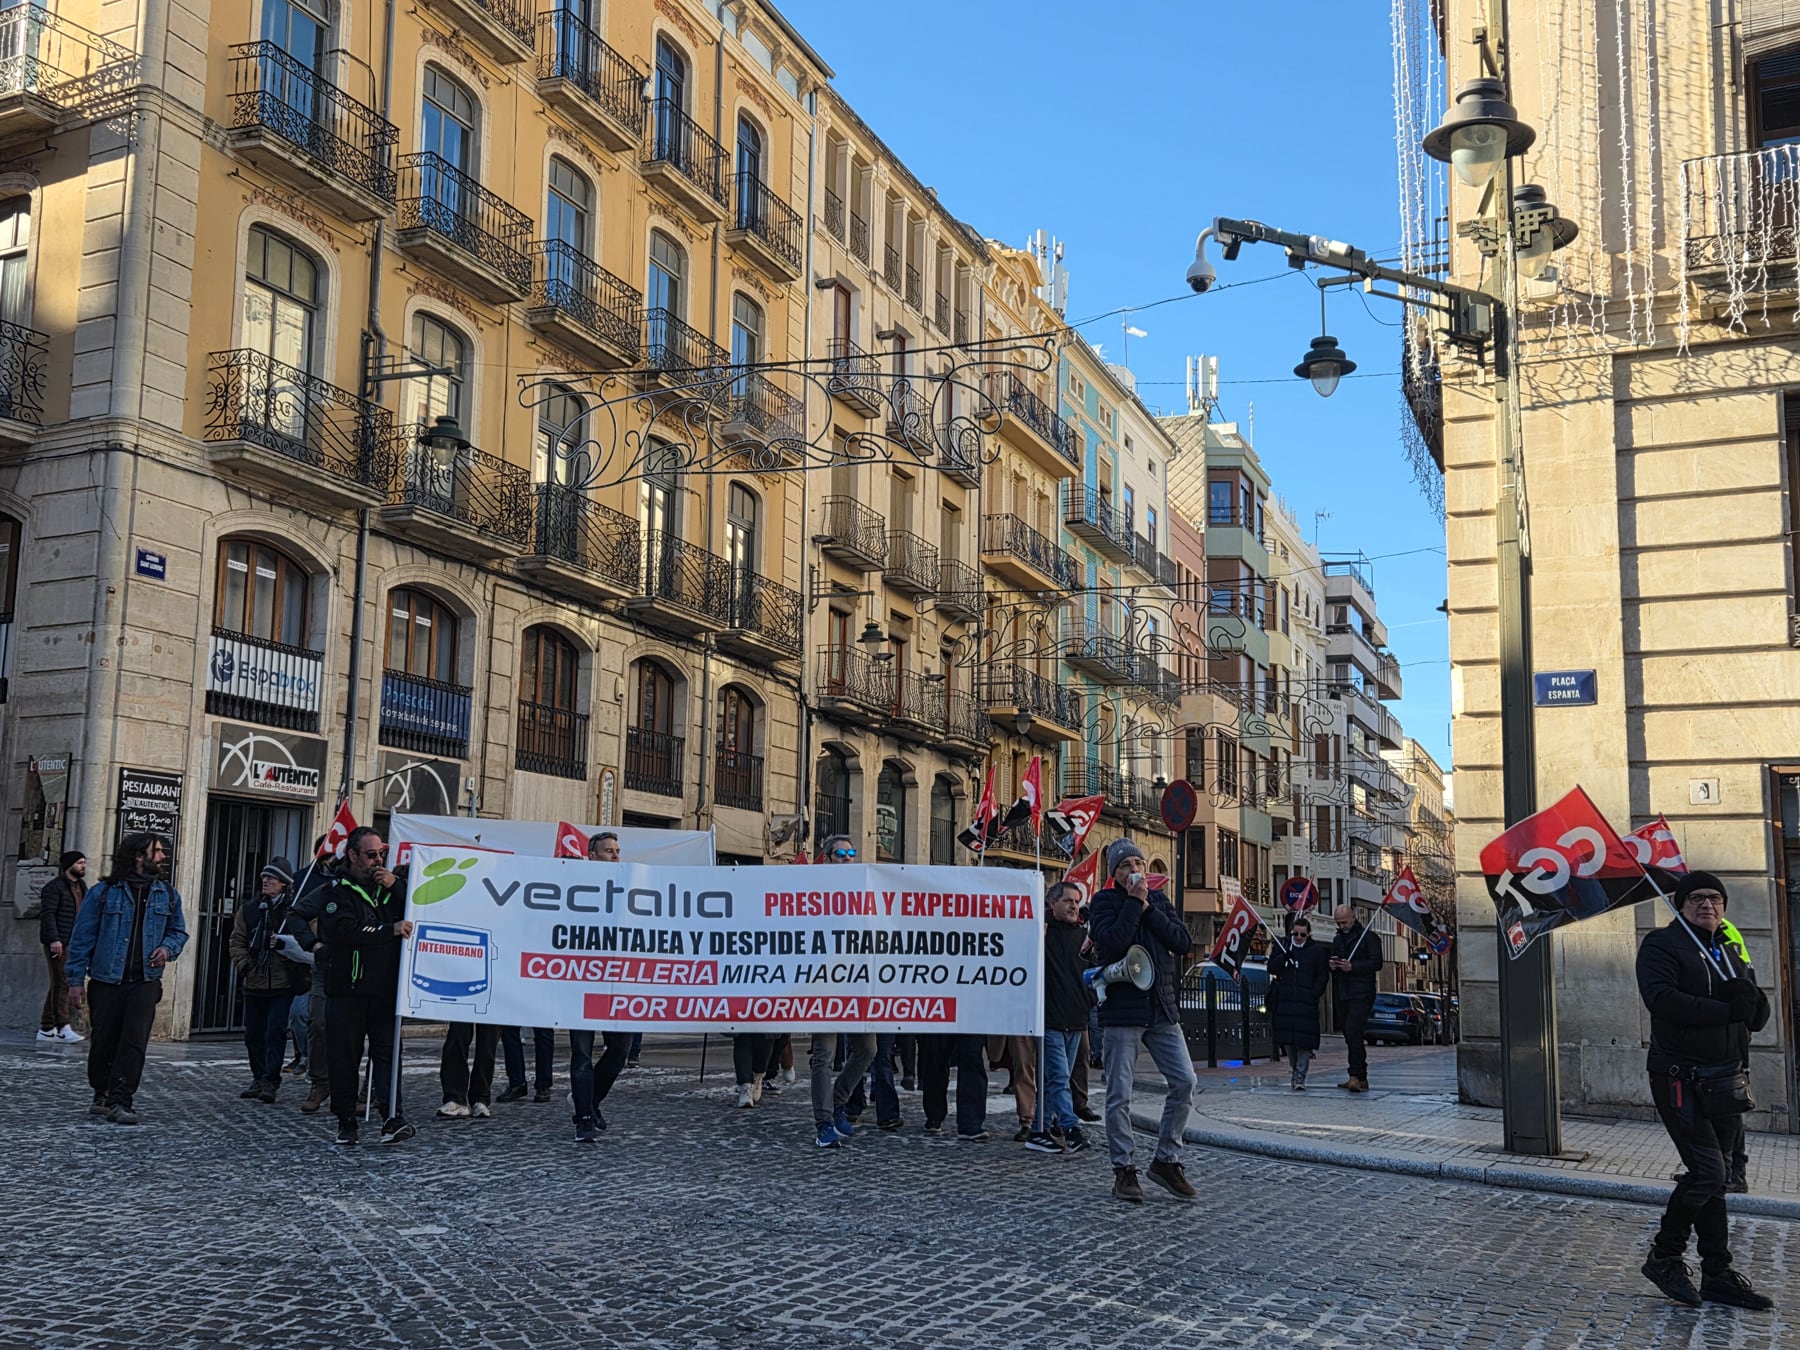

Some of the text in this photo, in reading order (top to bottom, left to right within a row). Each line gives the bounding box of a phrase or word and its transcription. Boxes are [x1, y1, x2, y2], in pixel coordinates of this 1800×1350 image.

[1551, 676, 1576, 686] PLAÇA
[1548, 690, 1580, 699] ESPANYA
[122, 780, 181, 798] RESTAURANT
[253, 780, 315, 794] Café-Restaurant
[481, 877, 733, 919] vectalia
[764, 891, 1034, 919] PRESIONA Y EXPEDIENTA
[418, 941, 484, 959] INTERURBANO
[551, 924, 1005, 957] CHANTAJEA Y DESPIDE A TRABAJADORES
[527, 956, 1028, 987] CONSELLERÍA MIRA HACIA OTRO LADO
[609, 997, 947, 1020] POR UNA JORNADA DIGNA
